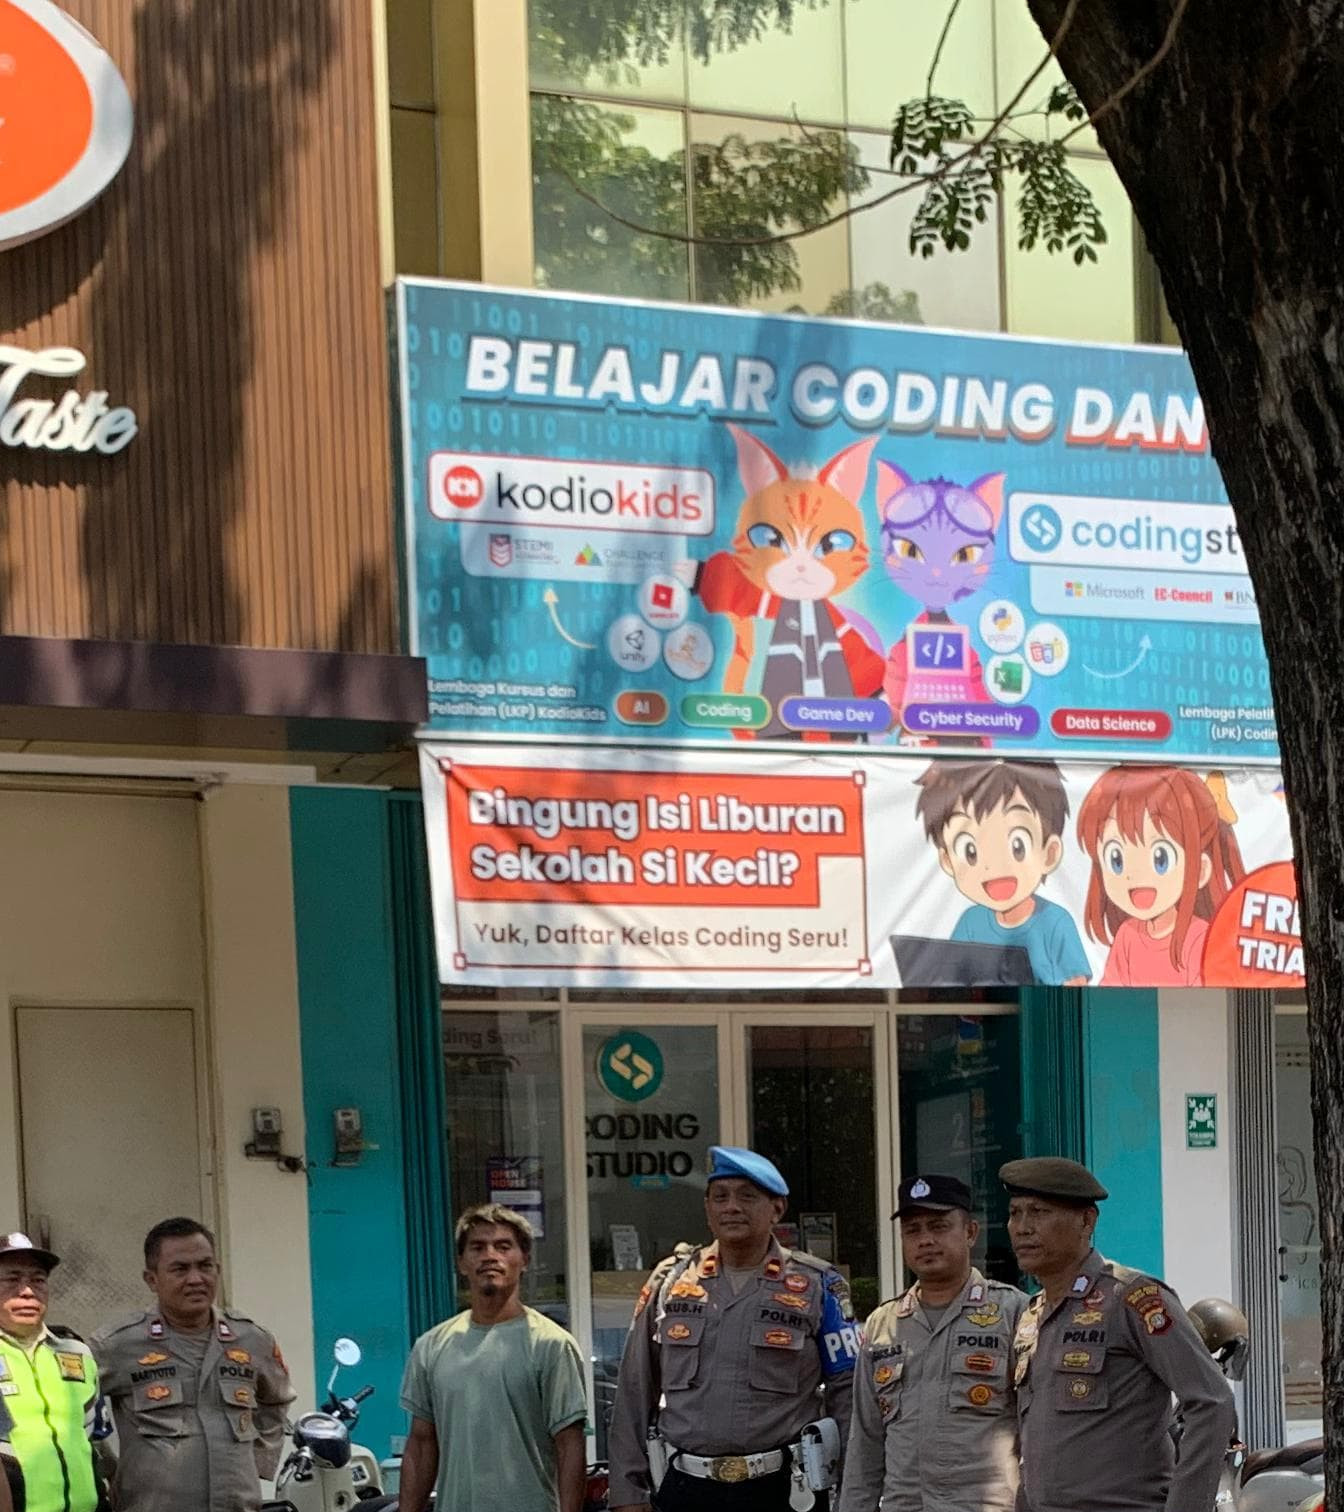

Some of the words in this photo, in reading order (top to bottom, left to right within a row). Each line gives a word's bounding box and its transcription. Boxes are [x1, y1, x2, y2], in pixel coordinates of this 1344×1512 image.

[466, 336, 775, 413] BELAJAR
[792, 363, 1054, 434] CODING
[1070, 388, 1208, 446] DAN
[496, 473, 702, 521] kodiokids
[1071, 517, 1241, 563] codingst
[1086, 584, 1145, 600] Microsoft
[428, 680, 495, 697] Lembaga
[547, 685, 576, 698] dan
[632, 700, 651, 716] AI
[696, 702, 753, 723] Coding
[798, 705, 843, 724] Game
[846, 706, 875, 724] Dev
[1179, 706, 1236, 722] Lembaga
[918, 710, 961, 730] Cyber
[963, 712, 1023, 731] Security
[1066, 716, 1100, 730] Data
[1102, 717, 1156, 732] Science
[1211, 723, 1242, 742] (LPK)
[469, 789, 638, 840] Bingung
[647, 794, 690, 831] Isi
[699, 797, 844, 834] Liburan
[471, 845, 634, 884] Sekolah
[642, 847, 676, 885] Si
[685, 851, 801, 887] Kecil?
[475, 923, 528, 946] Yuk,
[536, 924, 615, 946] Daftar
[621, 925, 689, 947] Kelas
[695, 926, 782, 952] Coding
[788, 928, 848, 949] Seru!
[585, 1114, 699, 1140] ODING
[760, 1309, 804, 1327] POLRI
[824, 1328, 859, 1363] PR
[957, 1335, 999, 1349] POLRI
[1063, 1331, 1105, 1345] POLRI
